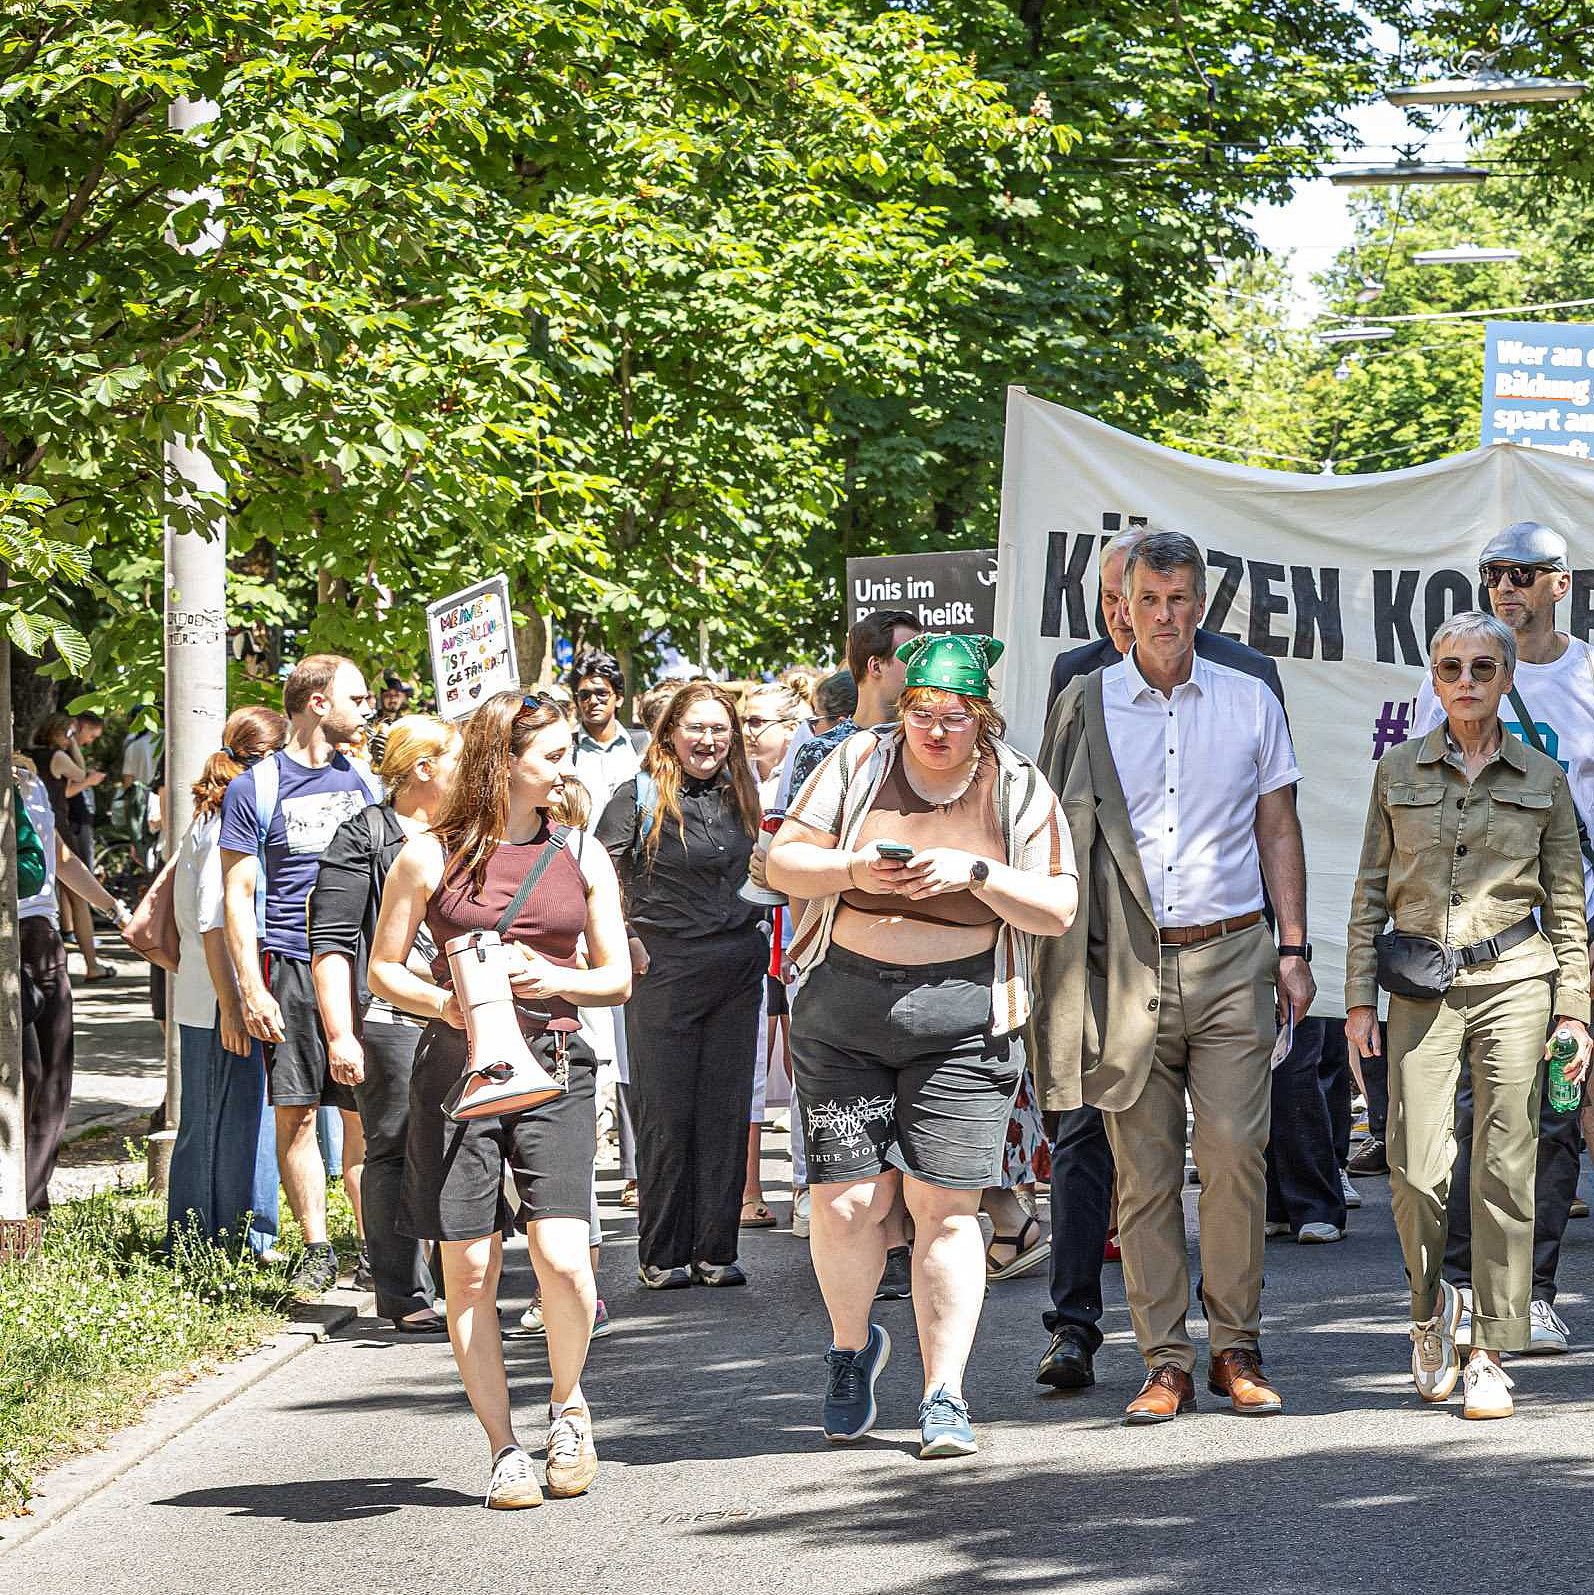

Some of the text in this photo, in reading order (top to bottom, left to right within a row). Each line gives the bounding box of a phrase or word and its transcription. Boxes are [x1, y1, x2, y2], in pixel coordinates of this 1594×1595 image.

[1497, 340, 1548, 366] Wer
[1551, 346, 1582, 367] an
[1496, 371, 1590, 406] Bildung
[1493, 409, 1560, 436] spart
[855, 577, 935, 601] Unis im
[1040, 512, 1344, 661] KZEN
[918, 602, 974, 626] heißt
[810, 1140, 888, 1164] TRUE NORT
